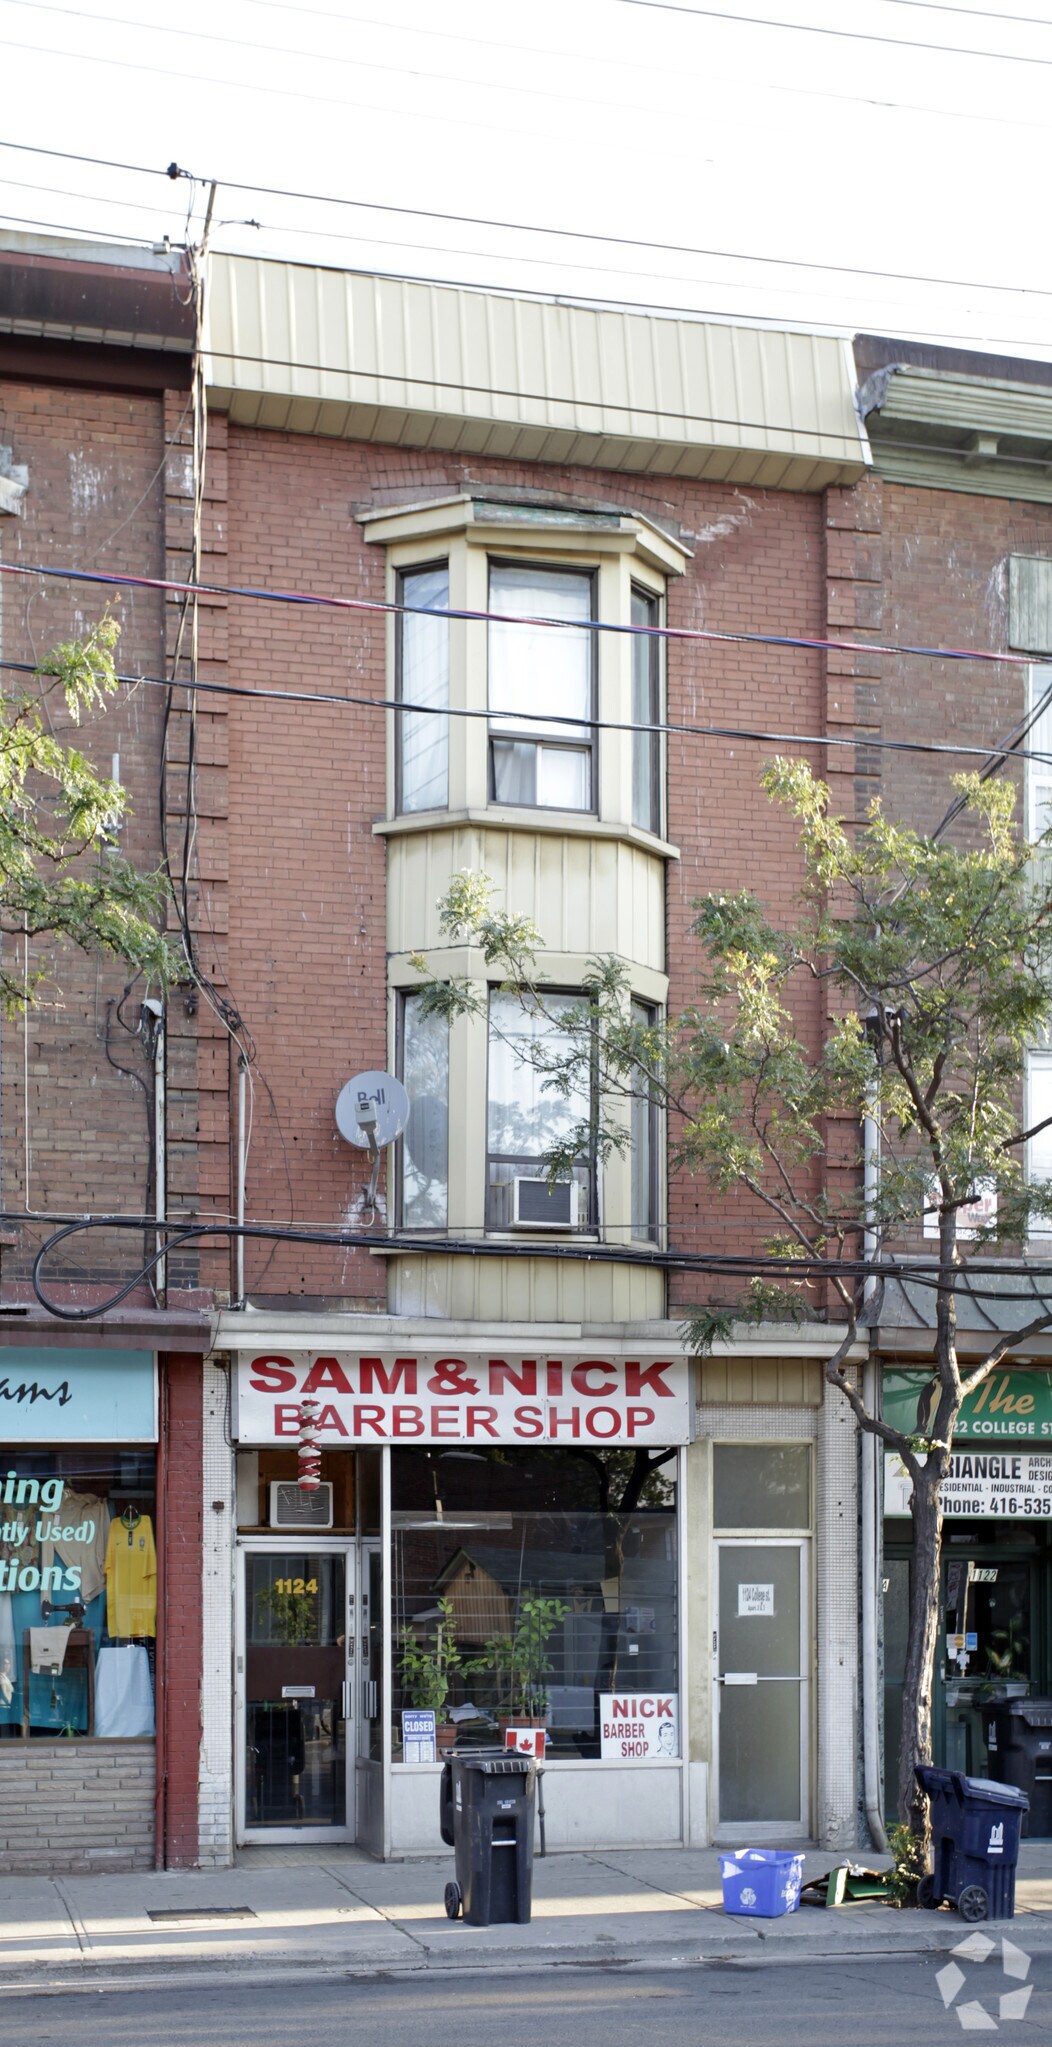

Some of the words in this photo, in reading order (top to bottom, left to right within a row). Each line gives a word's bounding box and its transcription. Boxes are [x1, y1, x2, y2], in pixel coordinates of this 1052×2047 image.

[249, 1355, 676, 1397] SAM&NICK
[969, 1375, 1035, 1414] The
[274, 1404, 501, 1438] BARBER
[513, 1405, 656, 1438] SHOP
[972, 1421, 1035, 1434] COLLEGE
[946, 1456, 1021, 1479] RIANGLE
[0, 1471, 65, 1512] ing
[939, 1482, 983, 1493] ESIDENTIAL
[991, 1483, 1035, 1494] INDUSTRIAL
[0, 1521, 29, 1547] tly
[35, 1520, 96, 1544] Used)
[0, 1558, 82, 1592] tions
[973, 1569, 996, 1581] 1122
[275, 1578, 318, 1594] 1124
[612, 1698, 673, 1718] NICK
[404, 1721, 434, 1732] CLOSED
[603, 1723, 645, 1738] BARBER
[621, 1741, 649, 1757] SHOP
